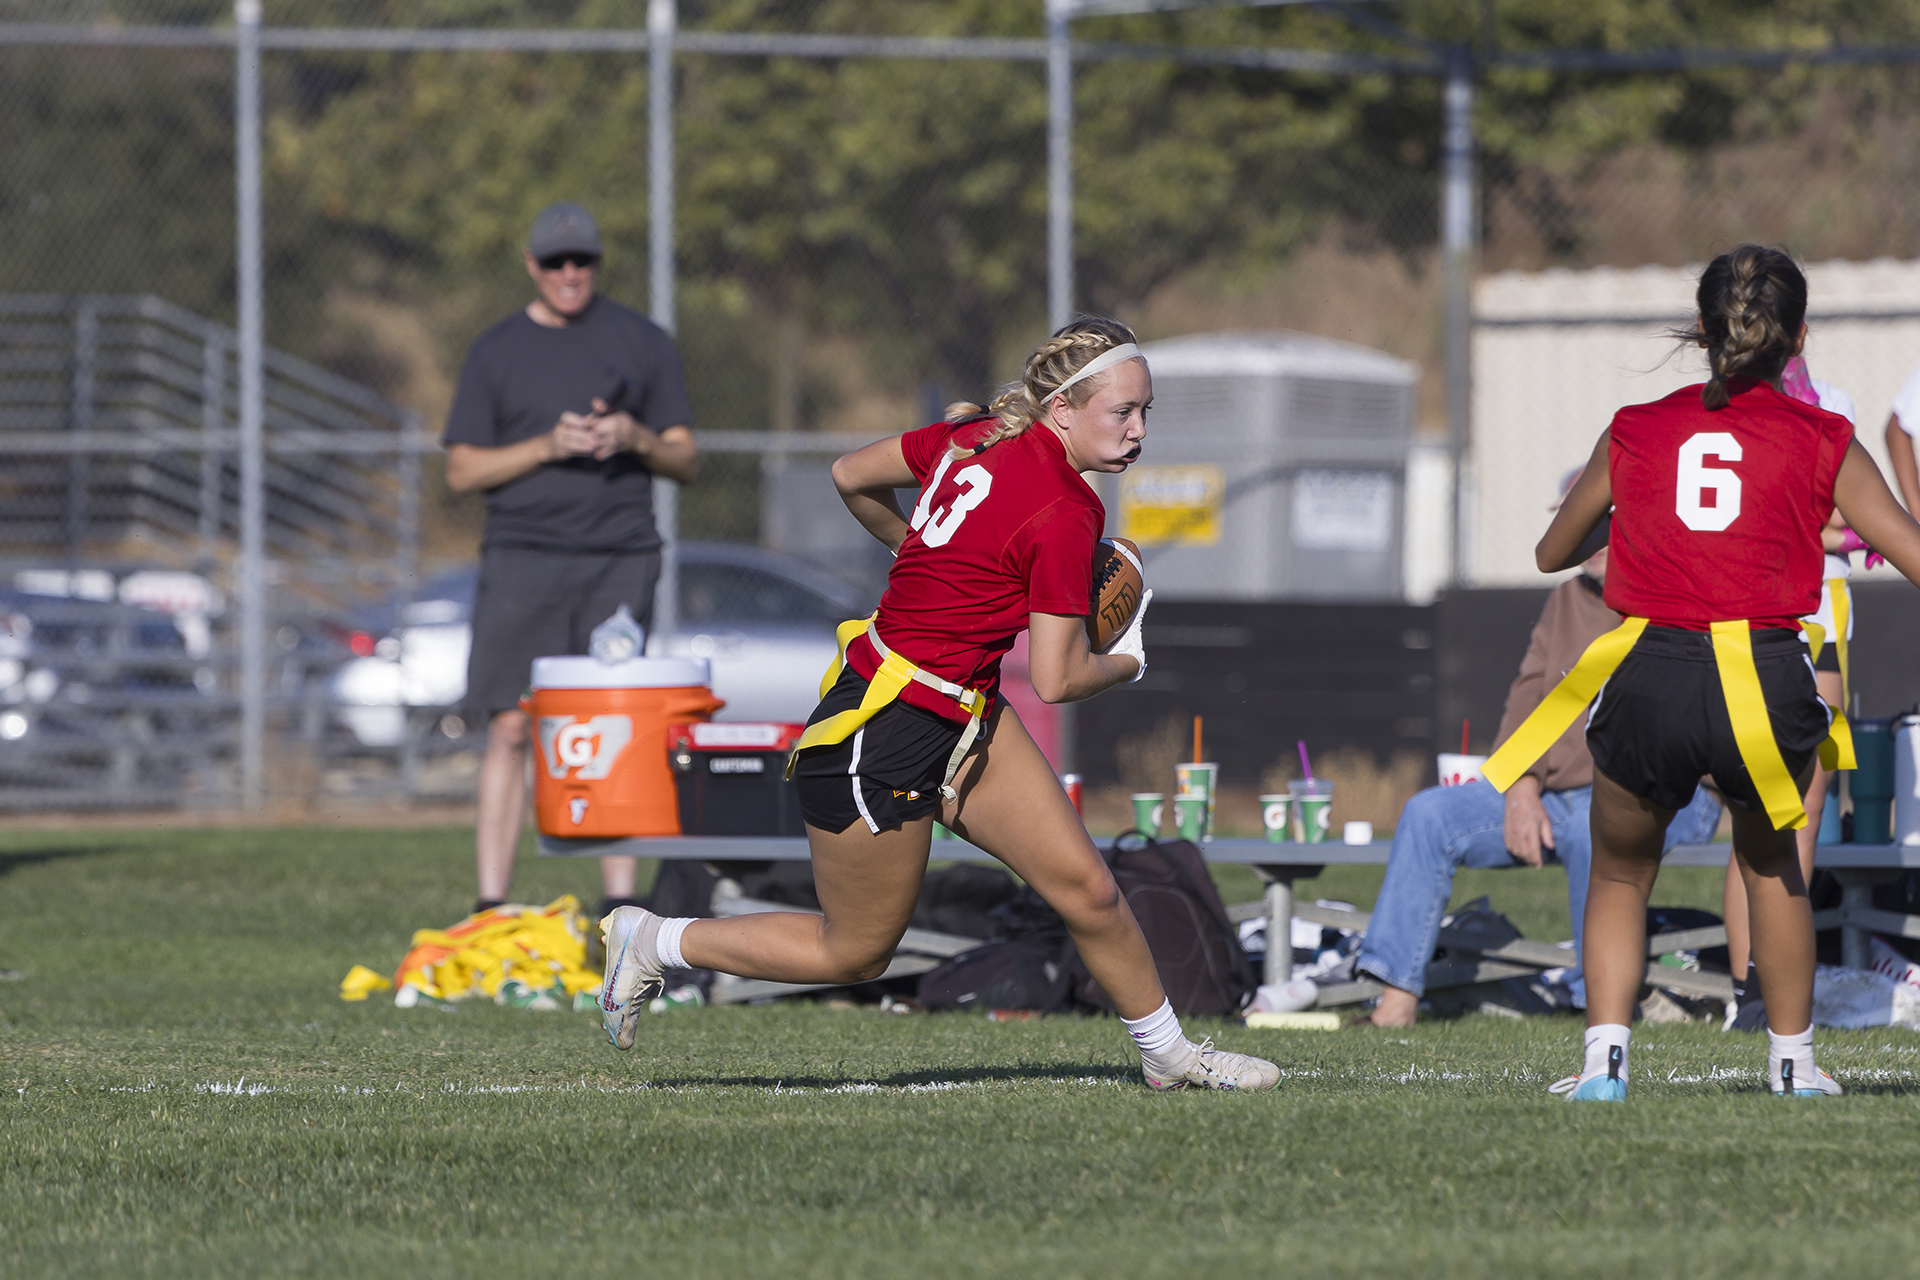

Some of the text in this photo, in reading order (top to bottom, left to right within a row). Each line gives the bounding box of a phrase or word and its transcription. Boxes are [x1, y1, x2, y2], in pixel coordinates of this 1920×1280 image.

[909, 448, 993, 548] 13
[1676, 432, 1743, 532] 6
[558, 723, 593, 767] G
